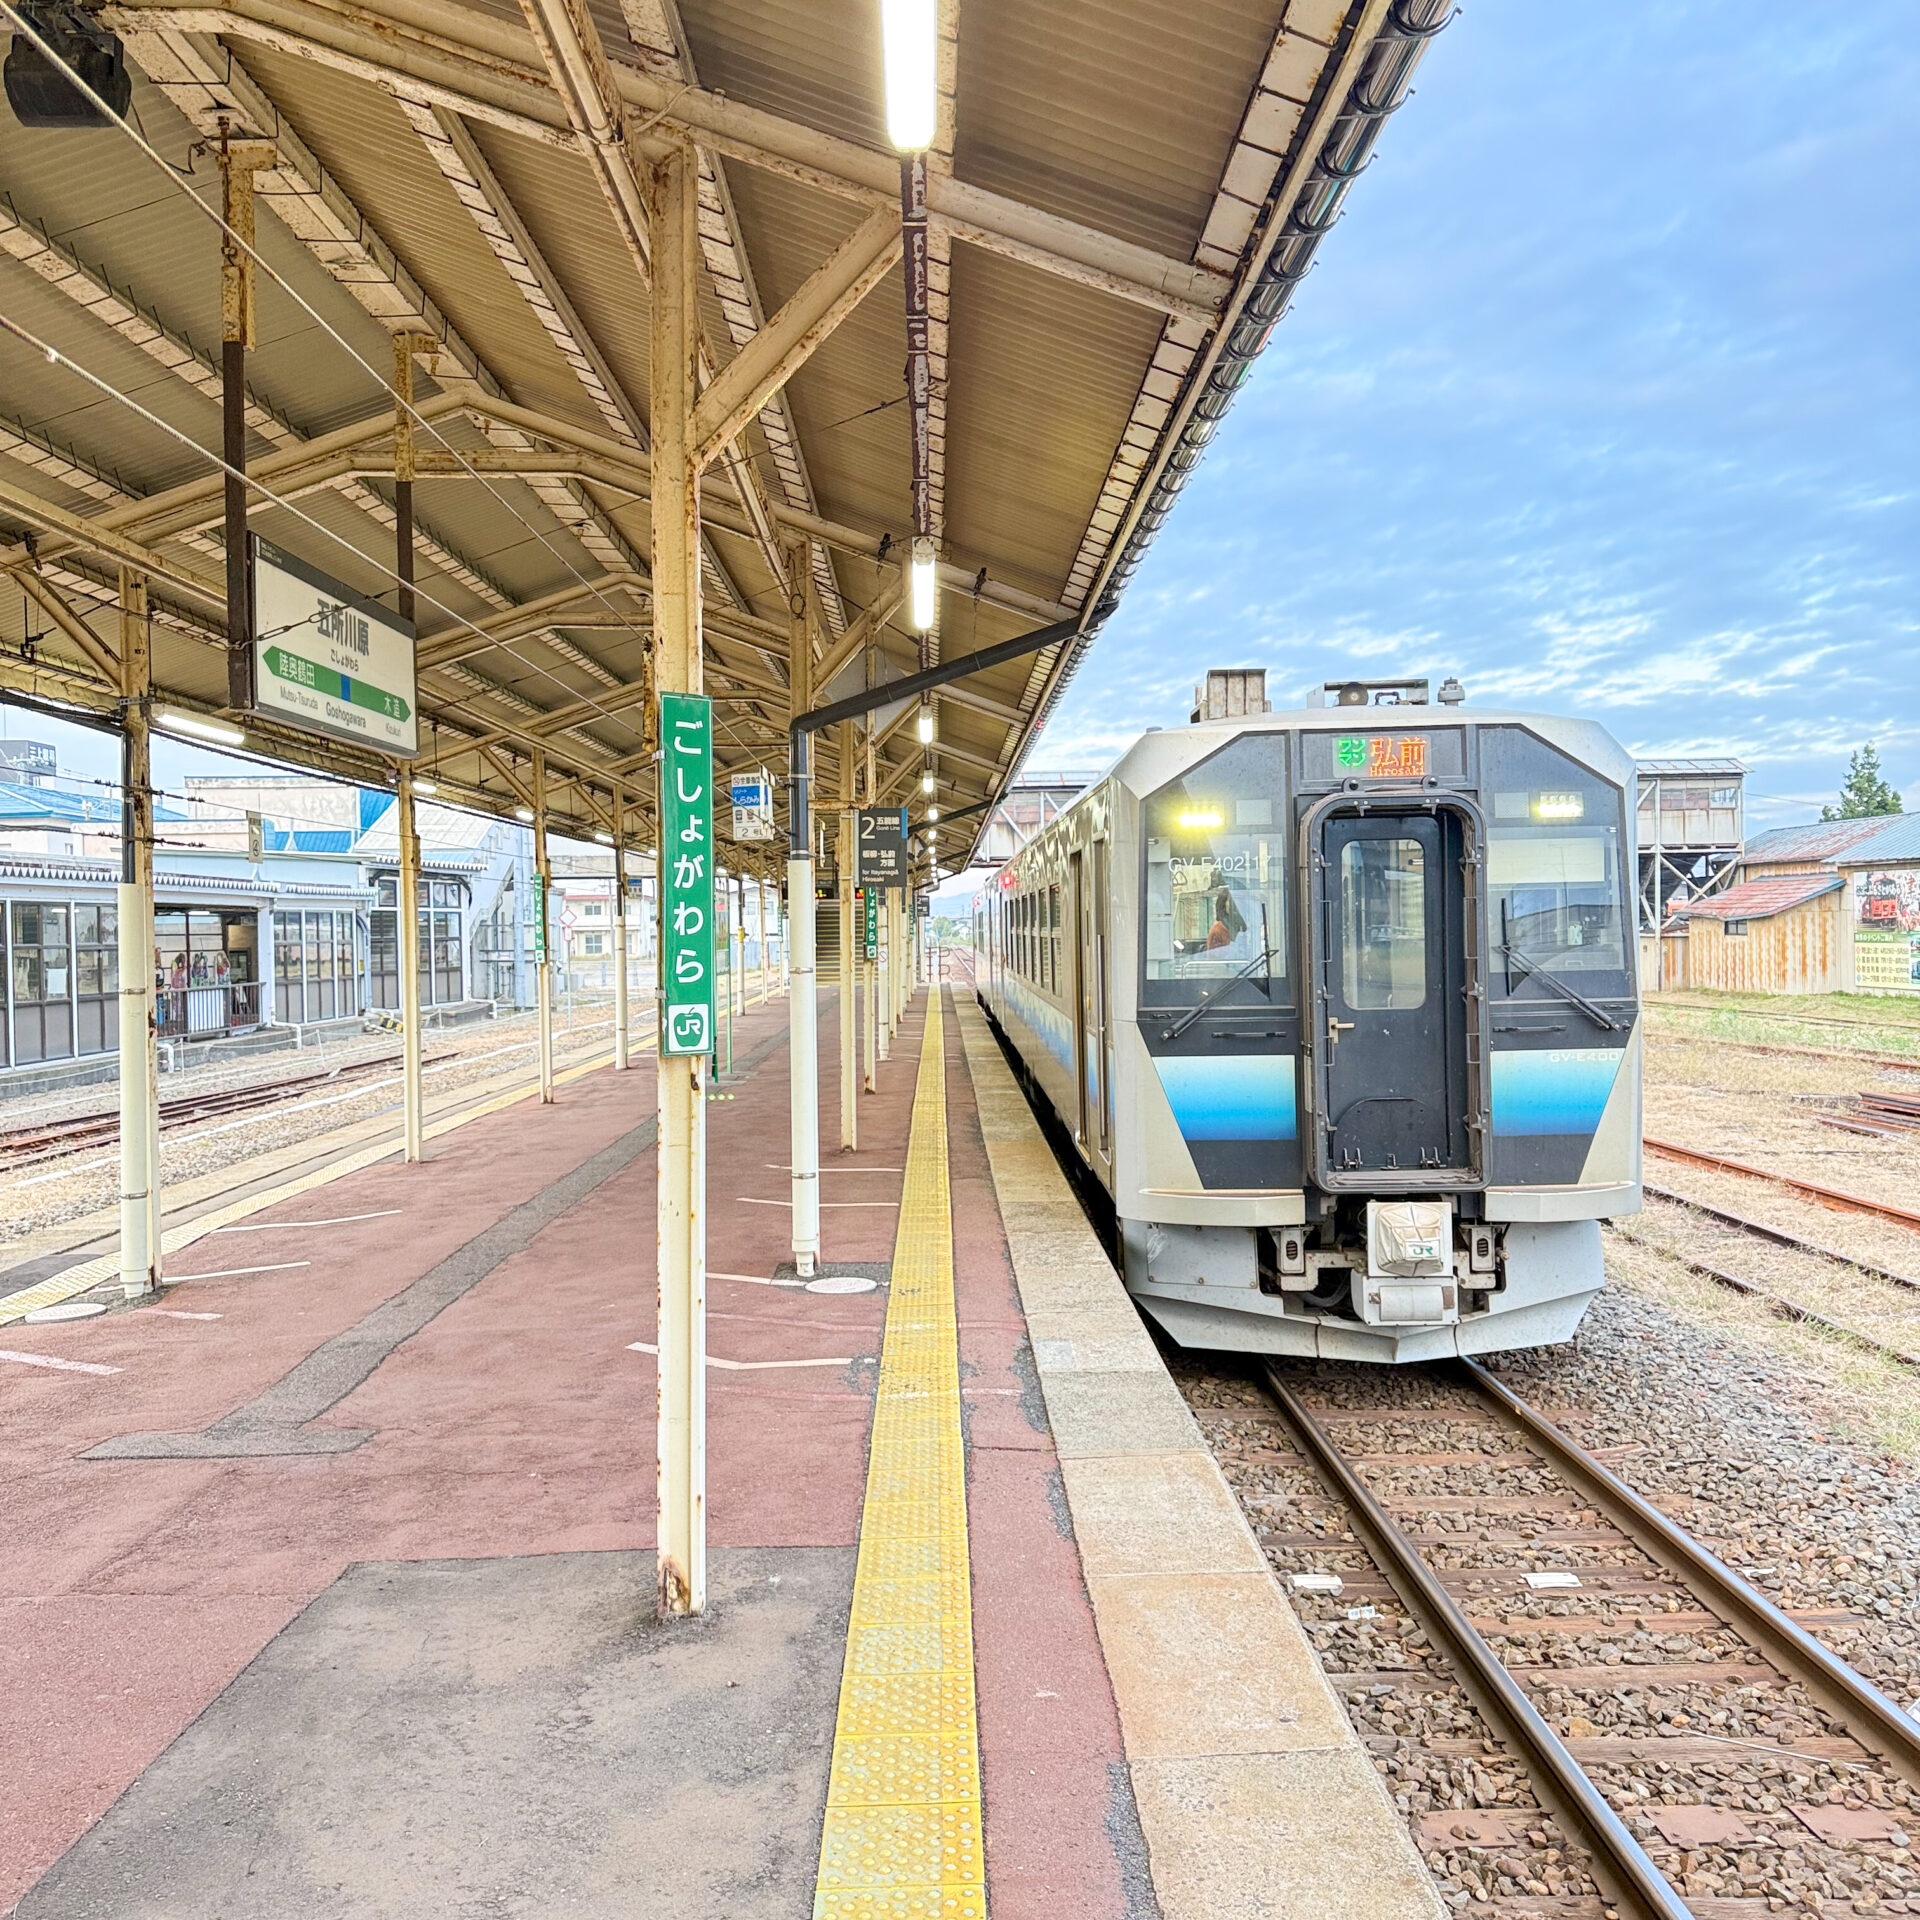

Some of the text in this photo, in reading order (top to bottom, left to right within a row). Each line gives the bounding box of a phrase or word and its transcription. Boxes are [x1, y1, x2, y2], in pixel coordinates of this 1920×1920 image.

[317, 597, 370, 657] 五所川原
[279, 651, 315, 688] 陸奥鶴田
[330, 648, 360, 672] ごしょがわら
[326, 701, 367, 729] Goshogawara
[1369, 736, 1428, 766] 弘前
[1369, 766, 1426, 776] Hirosaki
[742, 828, 749, 837] 2
[861, 816, 876, 840] 2
[673, 719, 705, 984] ごしょがわら
[868, 887, 876, 942] しょがわら
[676, 1018, 702, 1036] JR
[1549, 1050, 1619, 1063] GV-E400
